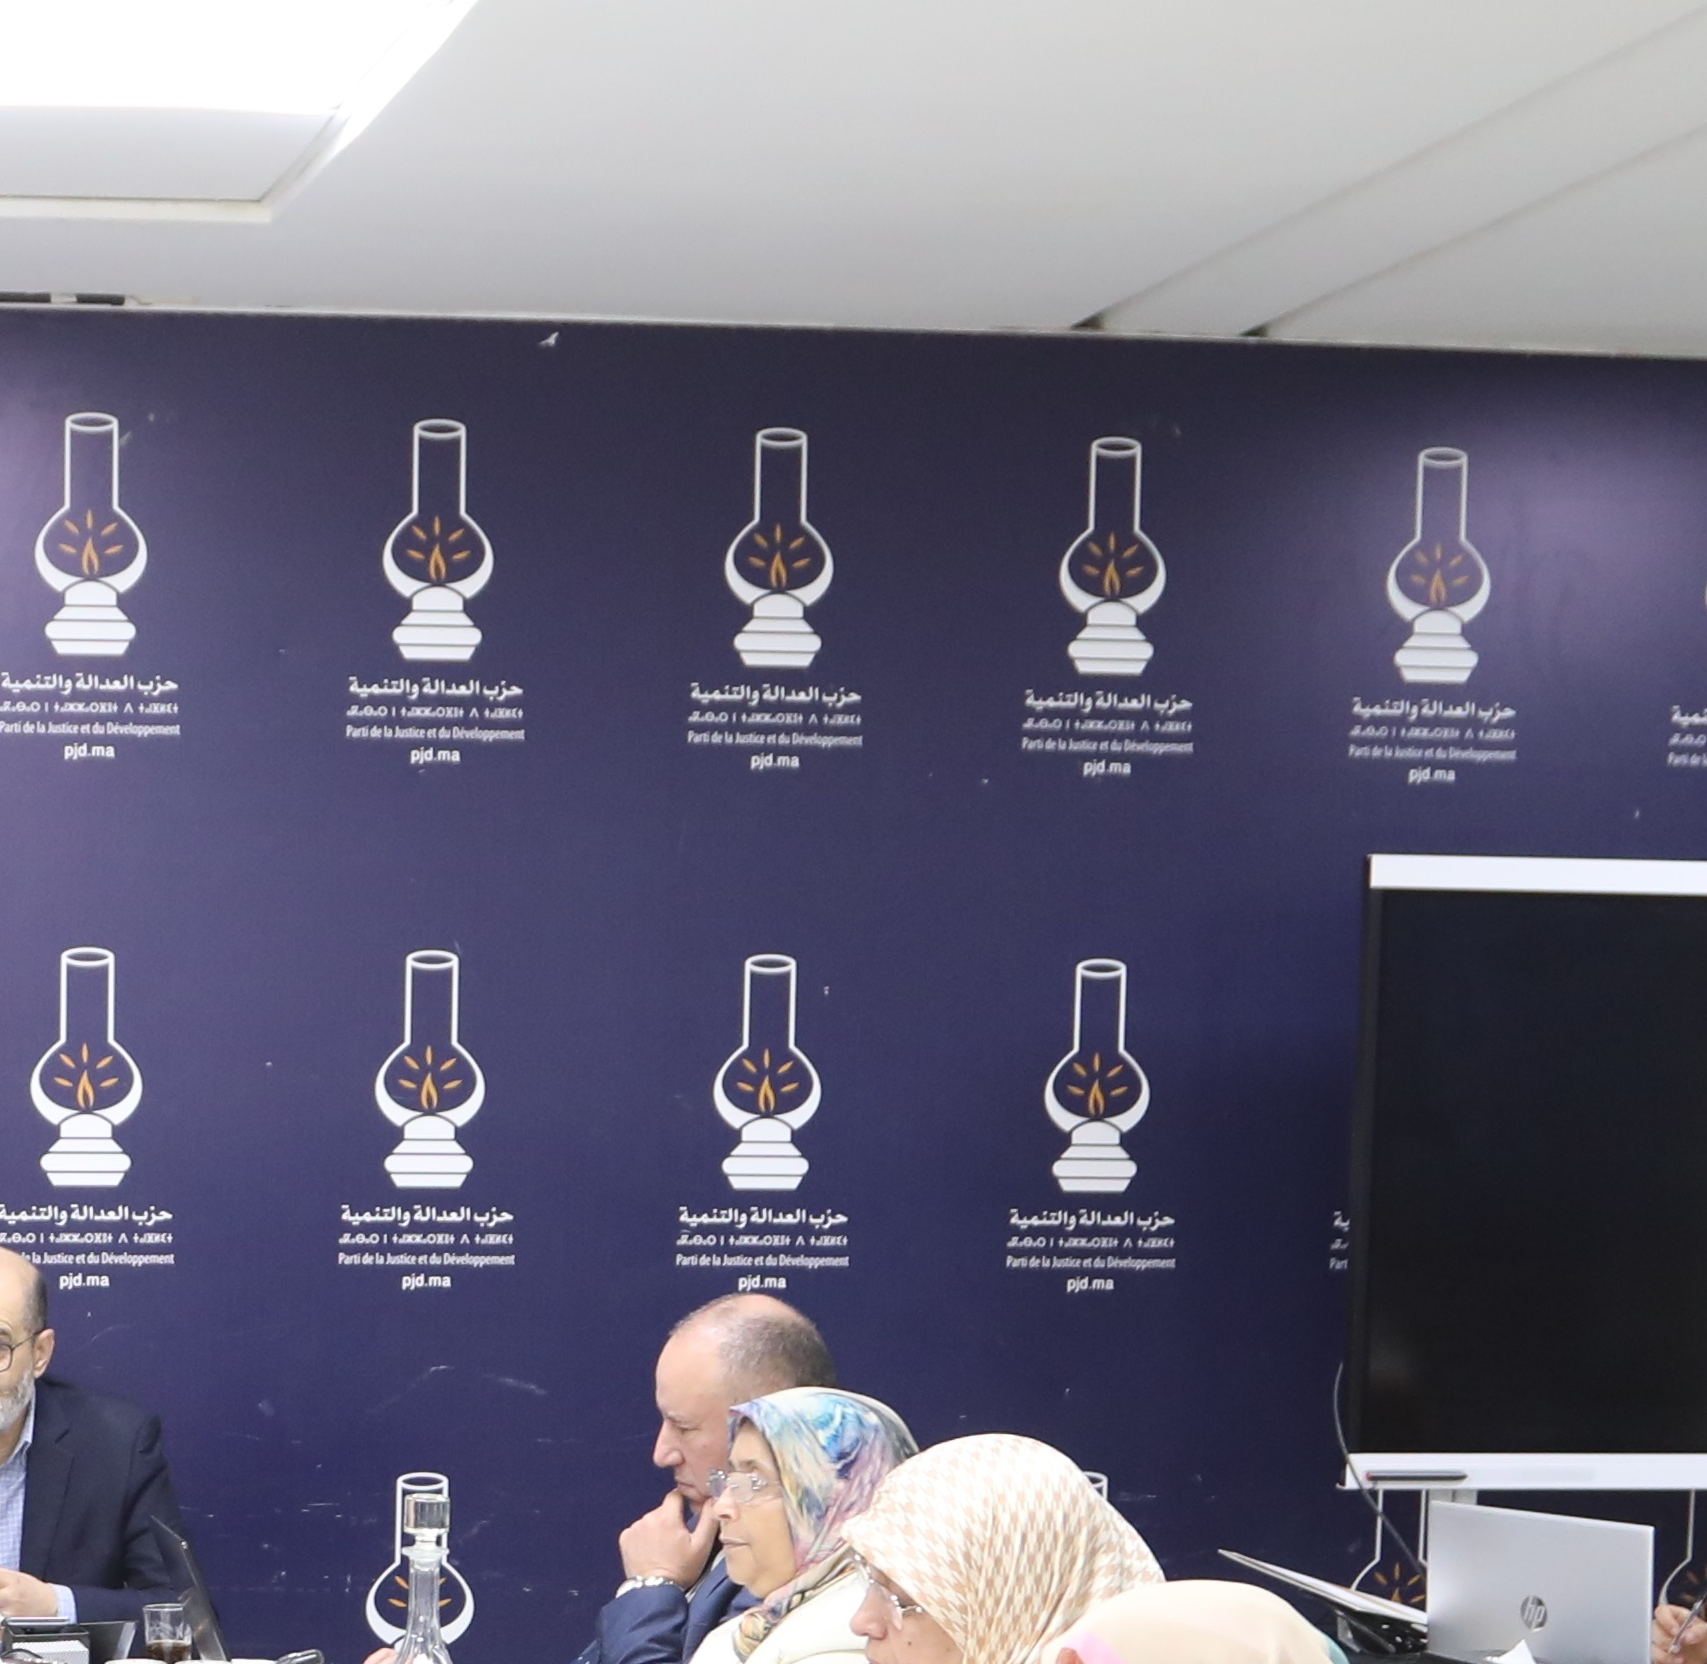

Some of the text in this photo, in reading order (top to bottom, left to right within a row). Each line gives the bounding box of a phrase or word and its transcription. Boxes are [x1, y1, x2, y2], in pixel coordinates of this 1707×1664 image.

[0, 672, 179, 696] حزب العدالة والتنمية
[348, 676, 524, 701] حزب العدالة والتنمية
[689, 682, 863, 707] حزب العدالة والتنمية
[22, 721, 35, 734] de
[36, 721, 46, 734] la
[47, 722, 80, 734] Justice
[80, 724, 91, 734] et
[91, 722, 106, 735] du
[106, 722, 181, 737] Développement
[63, 743, 115, 760] pjd.ma
[409, 748, 460, 765] pjd.ma
[749, 754, 800, 771] pjd.ma
[1082, 760, 1131, 777] pjd.ma
[1407, 769, 1455, 784] pjd.ma
[70, 1204, 130, 1222] العدالة
[131, 1206, 174, 1226] حزب
[340, 1205, 515, 1227] حزب العدالة والتنمية
[678, 1206, 849, 1229] حزب العدالة والتنمية
[1009, 1209, 1176, 1231] حزب العدالة والتنمية
[31, 1252, 176, 1267] la Justice et du Développement
[337, 1252, 516, 1268] Parti de la Justice et du Développement
[58, 1273, 110, 1290] pjd.ma
[400, 1274, 451, 1290] pjd.ma
[737, 1275, 787, 1290] pjd.ma
[1065, 1277, 1114, 1293] pjd.ma
[1523, 1595, 1546, 1629] hp
